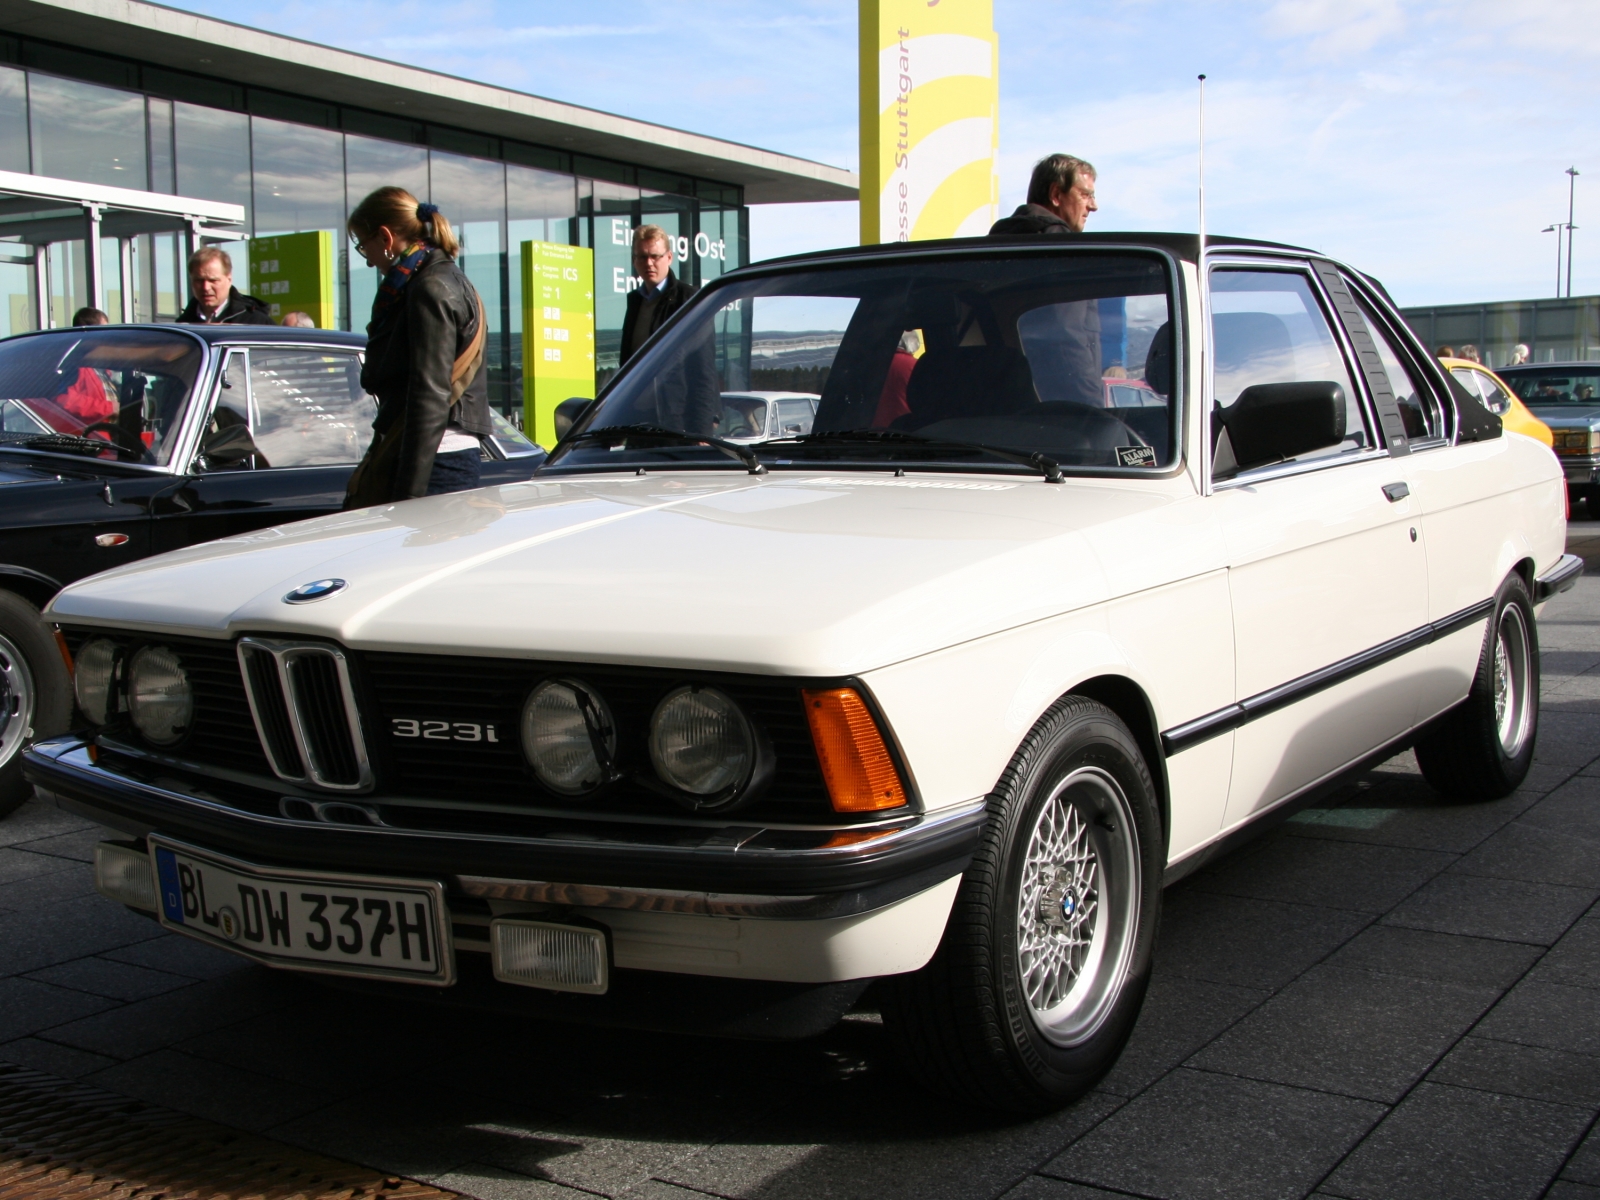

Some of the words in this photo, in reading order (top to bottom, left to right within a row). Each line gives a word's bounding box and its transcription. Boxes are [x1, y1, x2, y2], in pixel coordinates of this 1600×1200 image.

[895, 26, 912, 170] Stuttgart
[898, 181, 909, 243] esse
[611, 218, 689, 262] Eing
[694, 232, 726, 261] Ost
[563, 267, 578, 281] ICS
[555, 287, 560, 299] 1
[1123, 448, 1154, 463] ALARM
[391, 718, 499, 742] 323i
[168, 892, 177, 907] D
[178, 862, 219, 928] BL
[237, 883, 291, 948] DW
[300, 892, 431, 962] 337H
